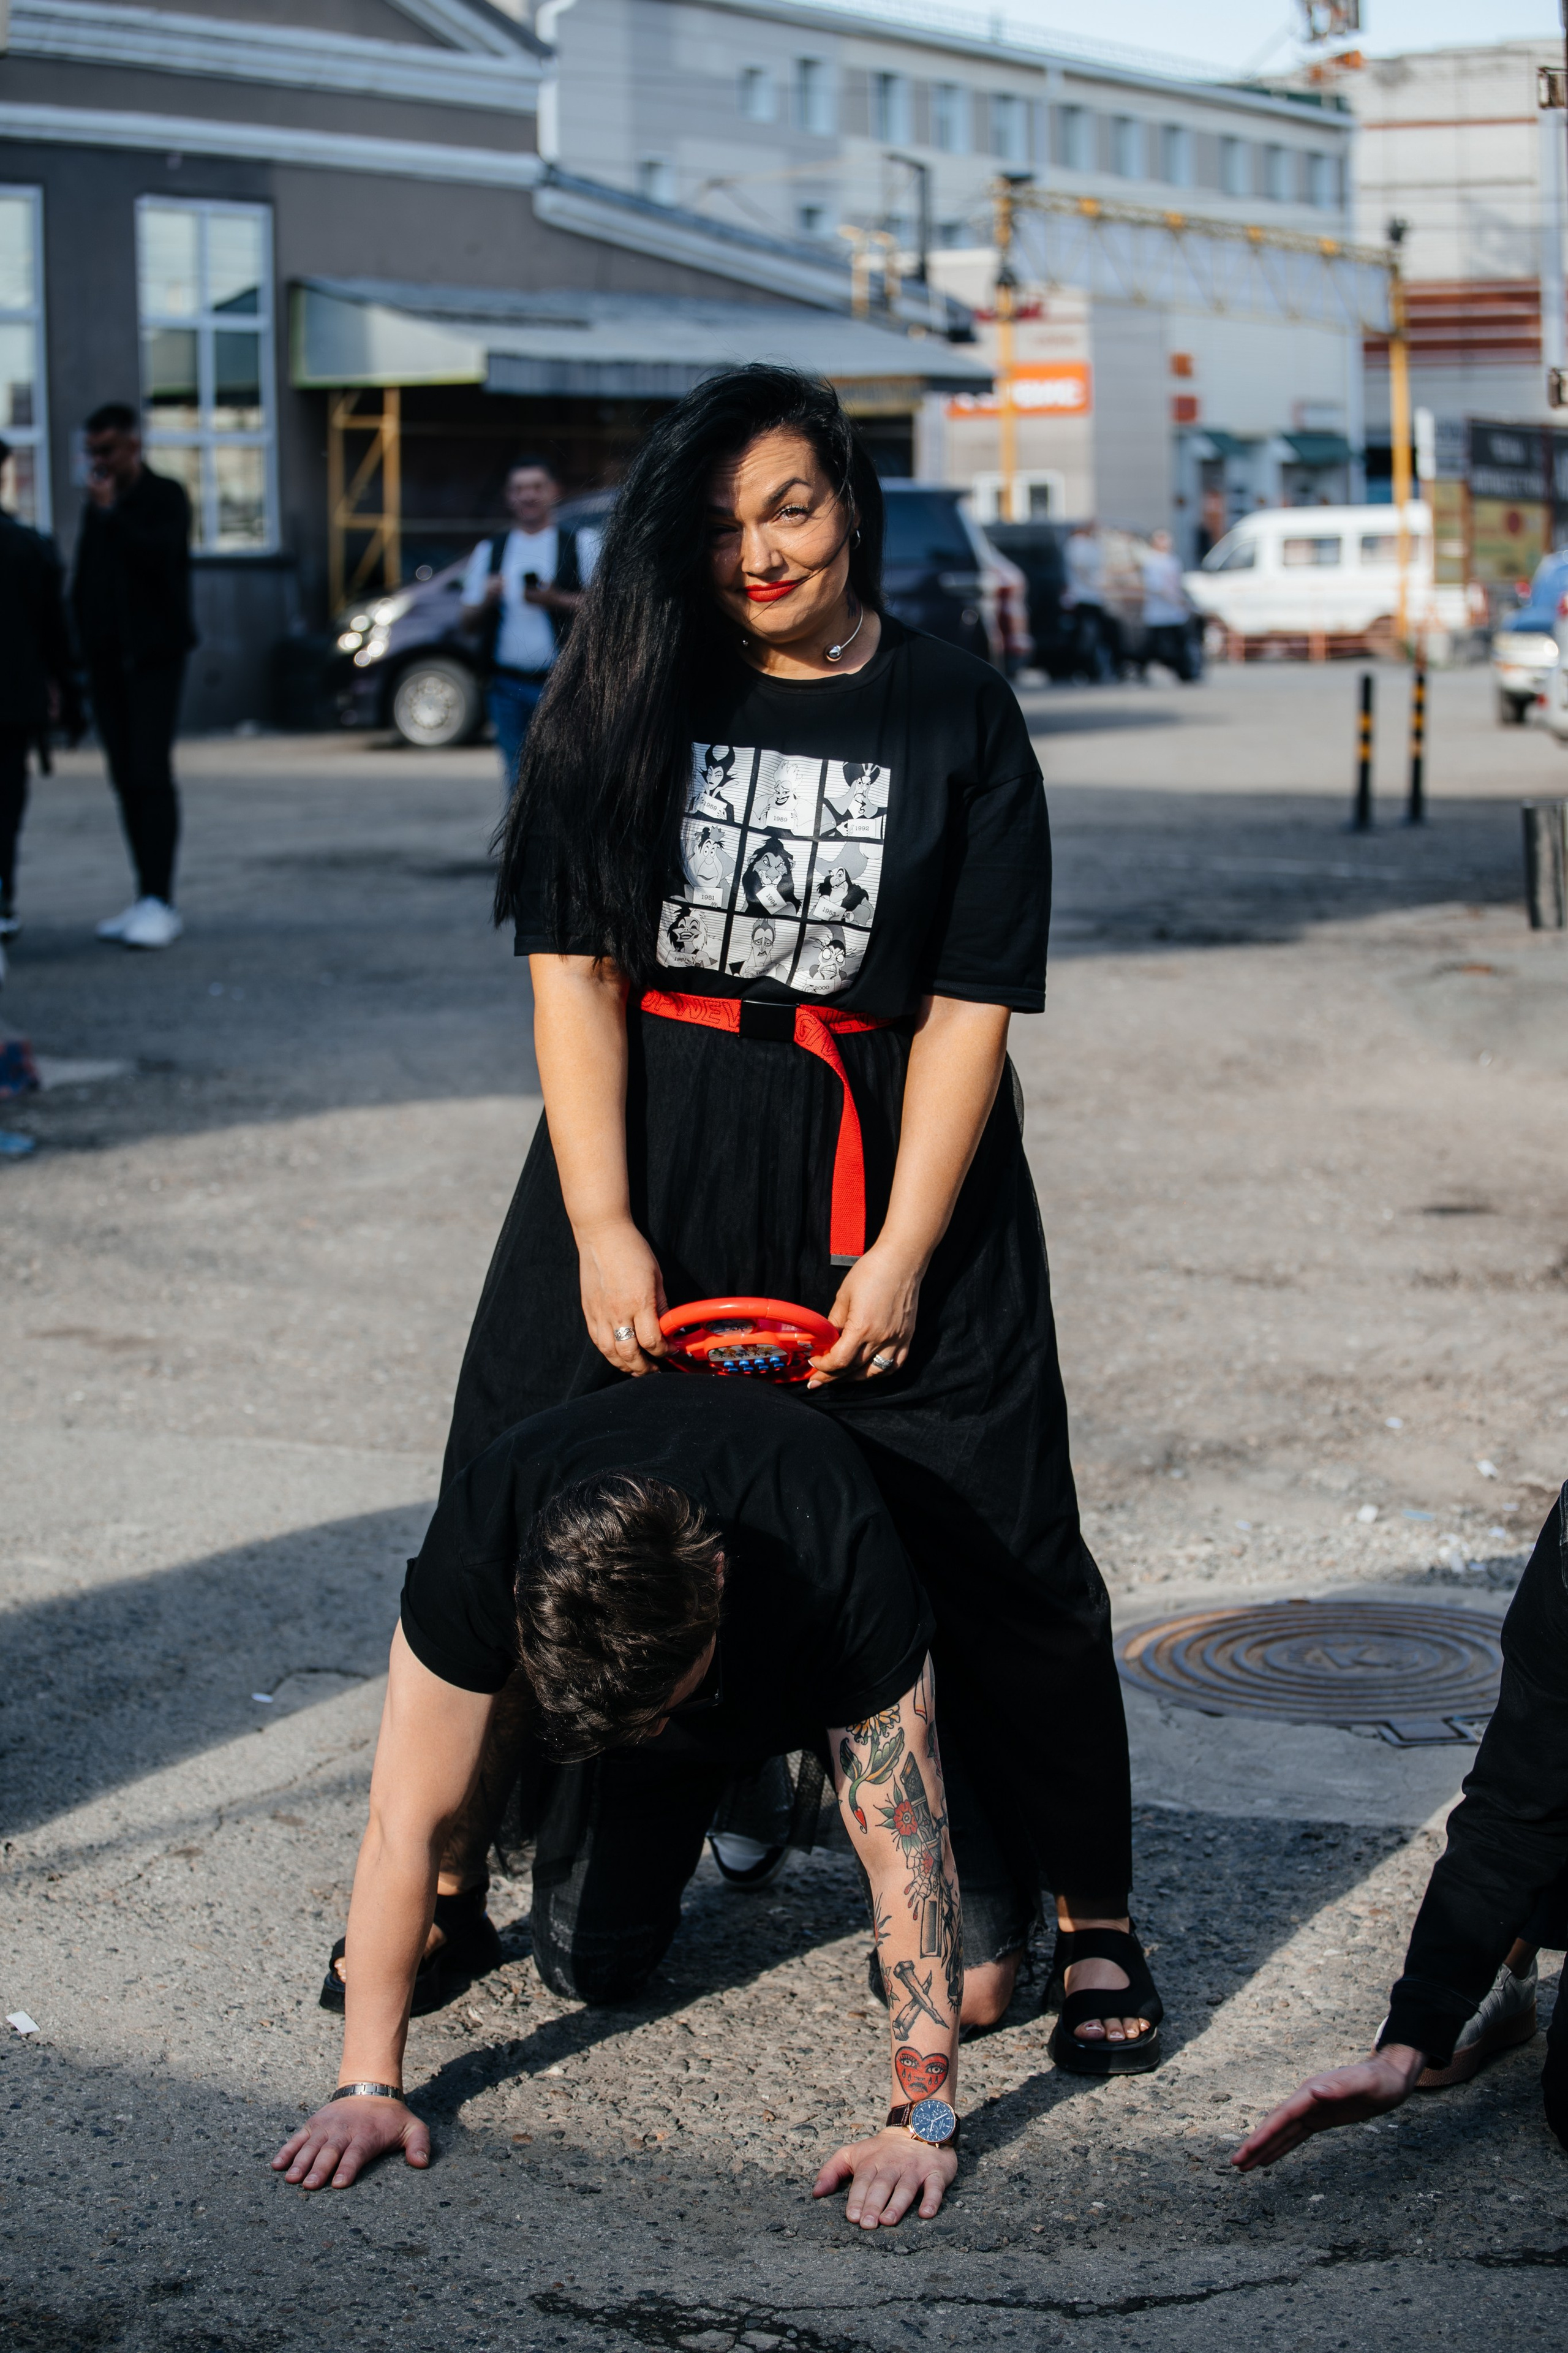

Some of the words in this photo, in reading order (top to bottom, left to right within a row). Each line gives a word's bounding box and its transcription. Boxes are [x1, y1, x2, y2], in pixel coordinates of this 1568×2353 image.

[703, 801, 717, 810] 1959
[766, 894, 777, 907] 1994
[822, 907, 837, 916] 1953
